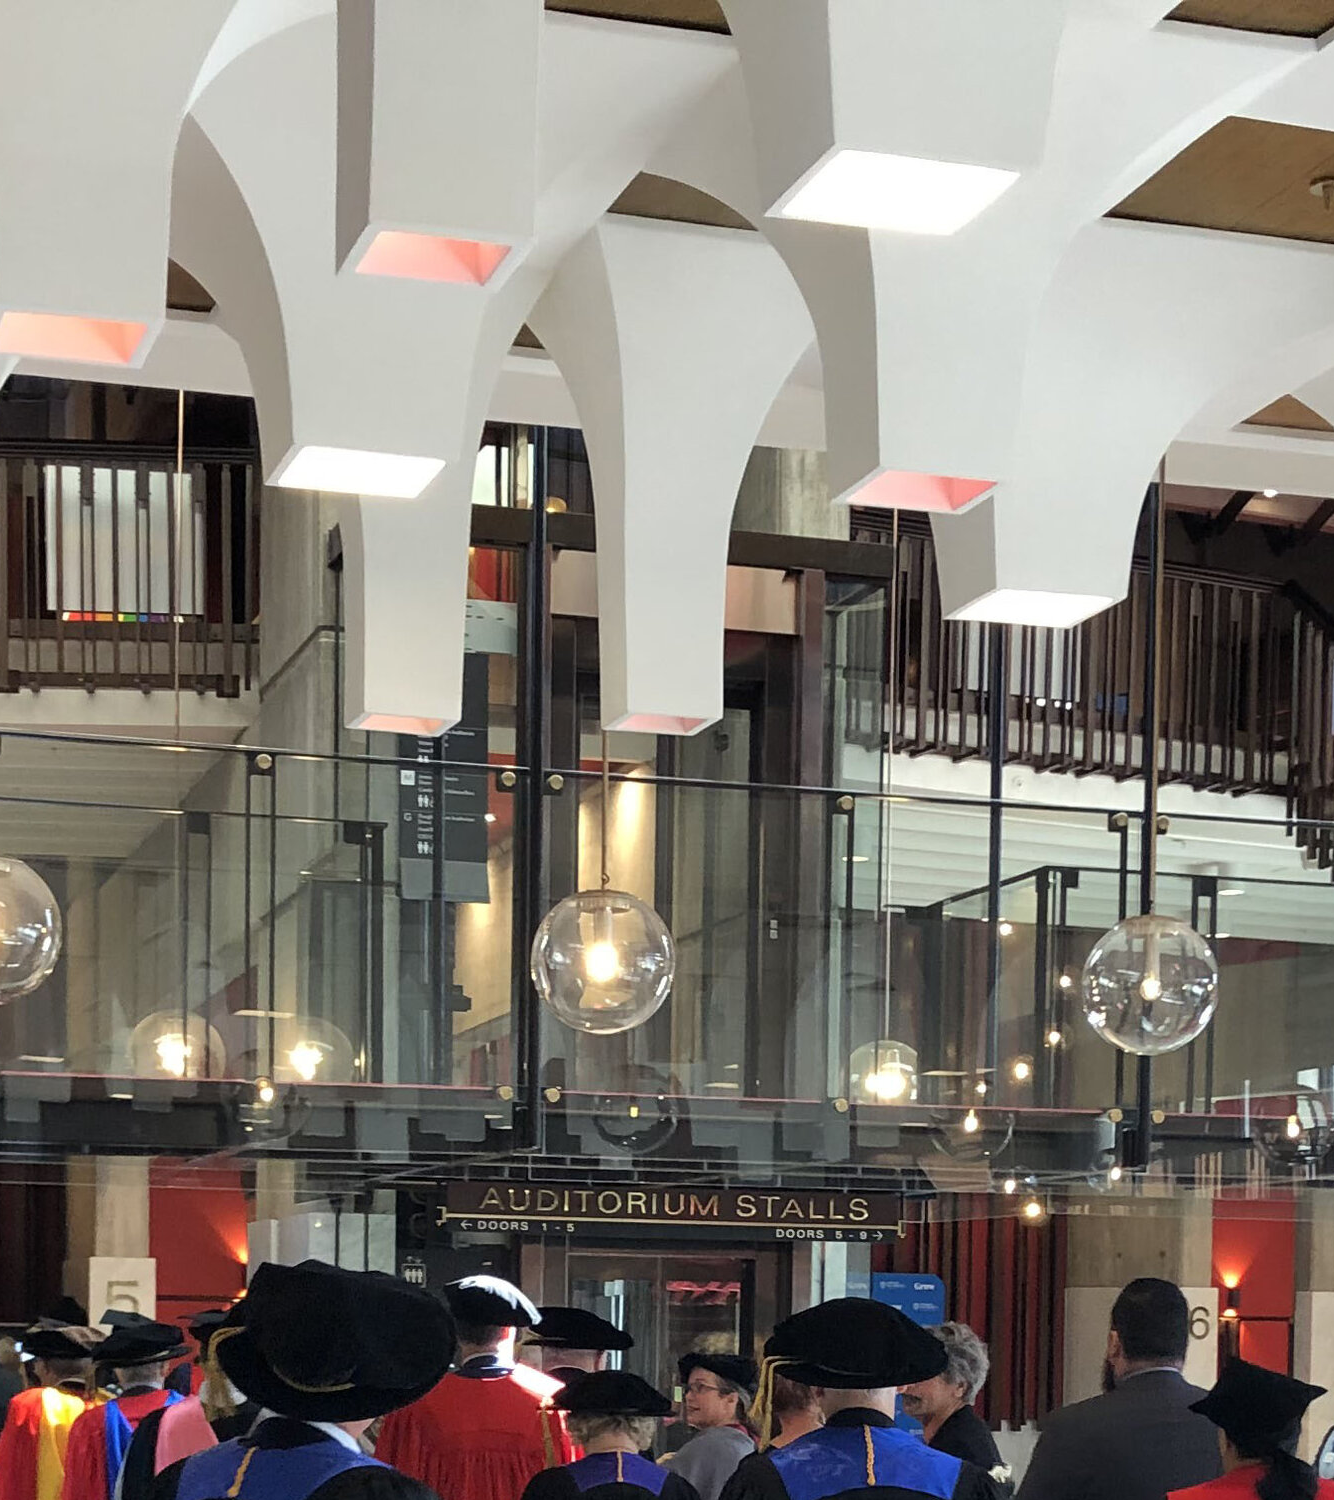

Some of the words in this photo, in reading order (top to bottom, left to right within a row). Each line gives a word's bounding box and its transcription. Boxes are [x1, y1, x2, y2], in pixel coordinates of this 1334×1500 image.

[478, 1187, 719, 1217] AUDITORIUM
[735, 1194, 870, 1221] STALLS
[477, 1220, 529, 1231] DOORS
[541, 1223, 547, 1232] 1
[567, 1224, 575, 1232] 5
[775, 1229, 825, 1239] DOORS
[835, 1230, 843, 1239] 5
[860, 1231, 868, 1240] 9
[107, 1281, 139, 1314] 5
[1190, 1306, 1210, 1340] 6
